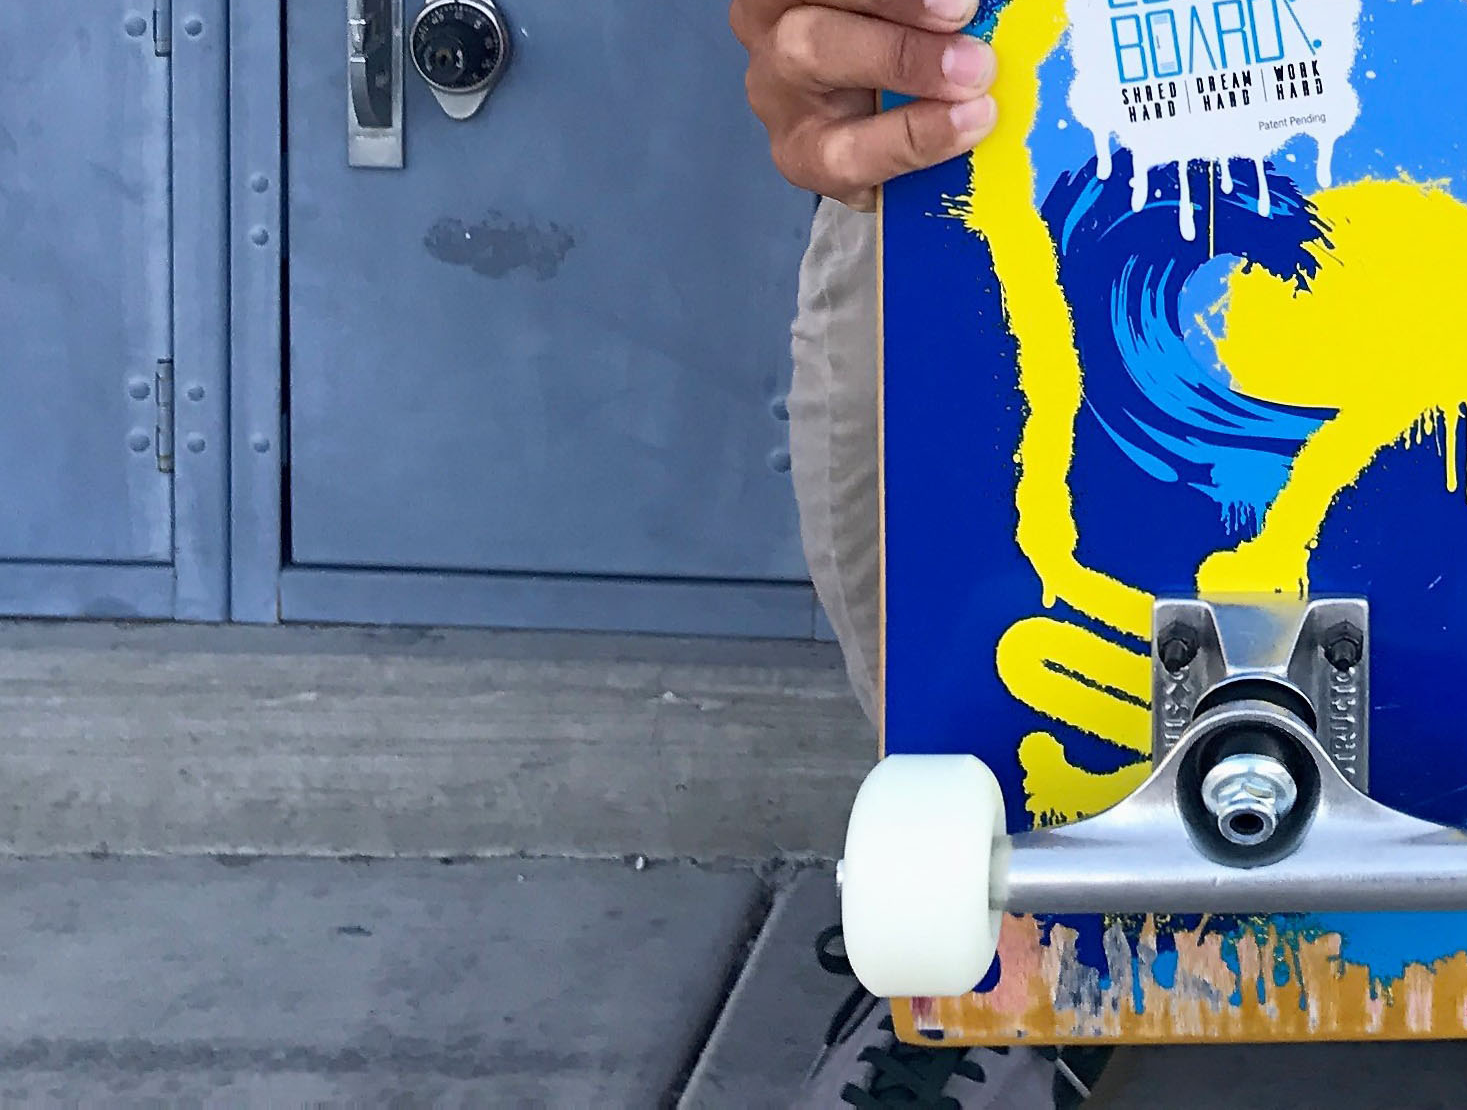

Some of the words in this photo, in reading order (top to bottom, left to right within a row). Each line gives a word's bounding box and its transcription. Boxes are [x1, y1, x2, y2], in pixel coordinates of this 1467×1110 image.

[1121, 81, 1177, 105] SHRED
[1196, 69, 1253, 94] DREAM
[1273, 60, 1321, 82] WORK
[1128, 100, 1176, 123] HARD
[1202, 89, 1250, 112] HARD
[1275, 77, 1324, 100] HARD
[1258, 118, 1288, 131] Patent
[1289, 112, 1327, 126] Pending
